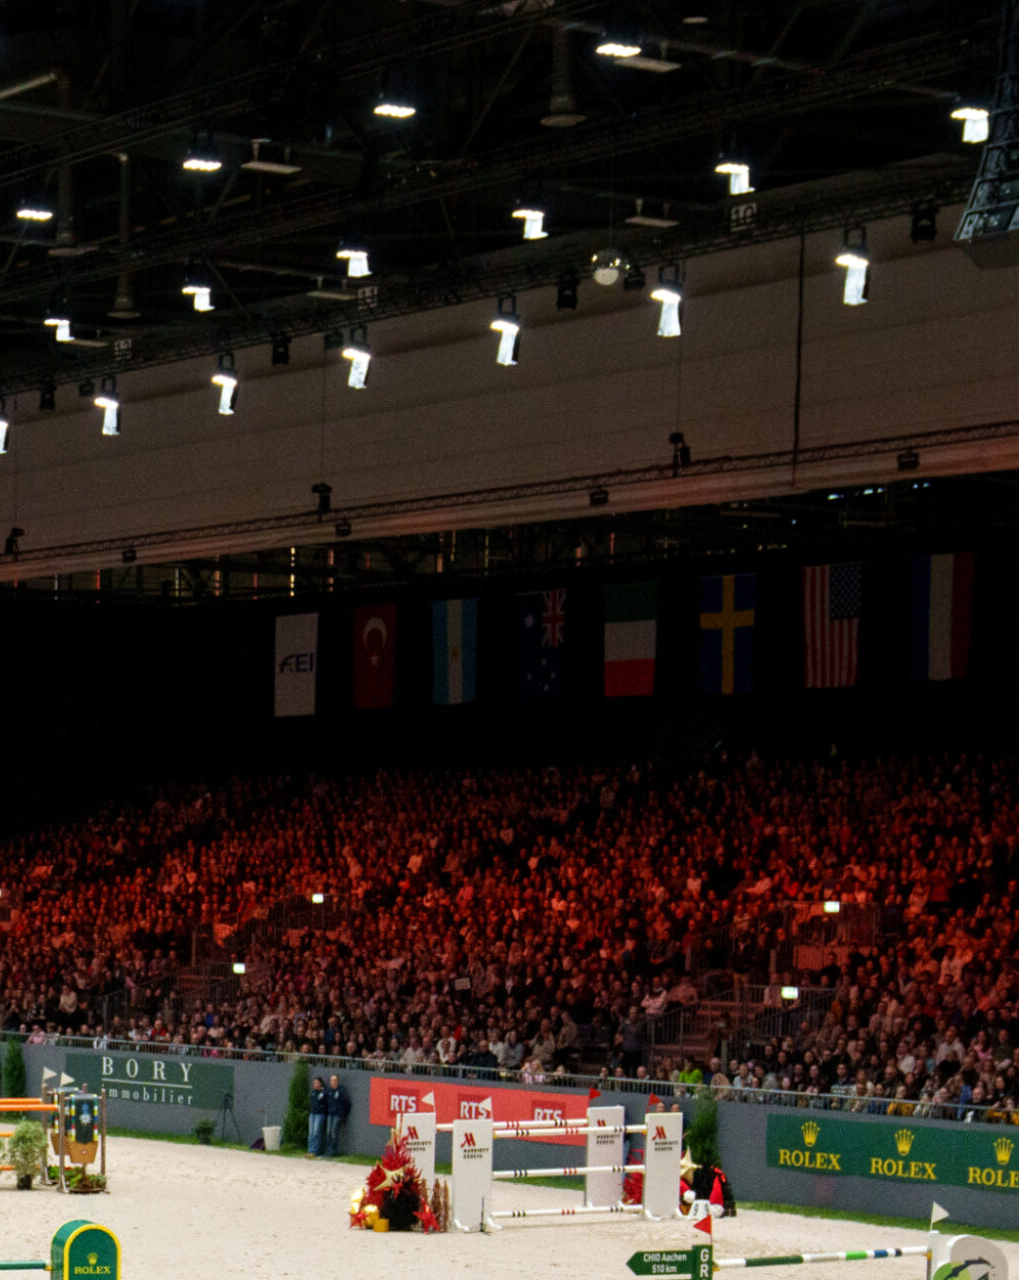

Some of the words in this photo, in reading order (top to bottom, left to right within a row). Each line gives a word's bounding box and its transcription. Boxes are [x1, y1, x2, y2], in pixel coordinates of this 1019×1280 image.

[102, 1056, 193, 1082] BORY
[390, 1094, 417, 1113] RTS
[460, 1101, 488, 1120] RTS
[778, 1149, 842, 1171] ROLEX
[870, 1157, 937, 1181] ROLEX
[967, 1166, 1019, 1189] ROLE
[74, 1265, 111, 1275] ROLEX
[666, 1264, 677, 1273] km
